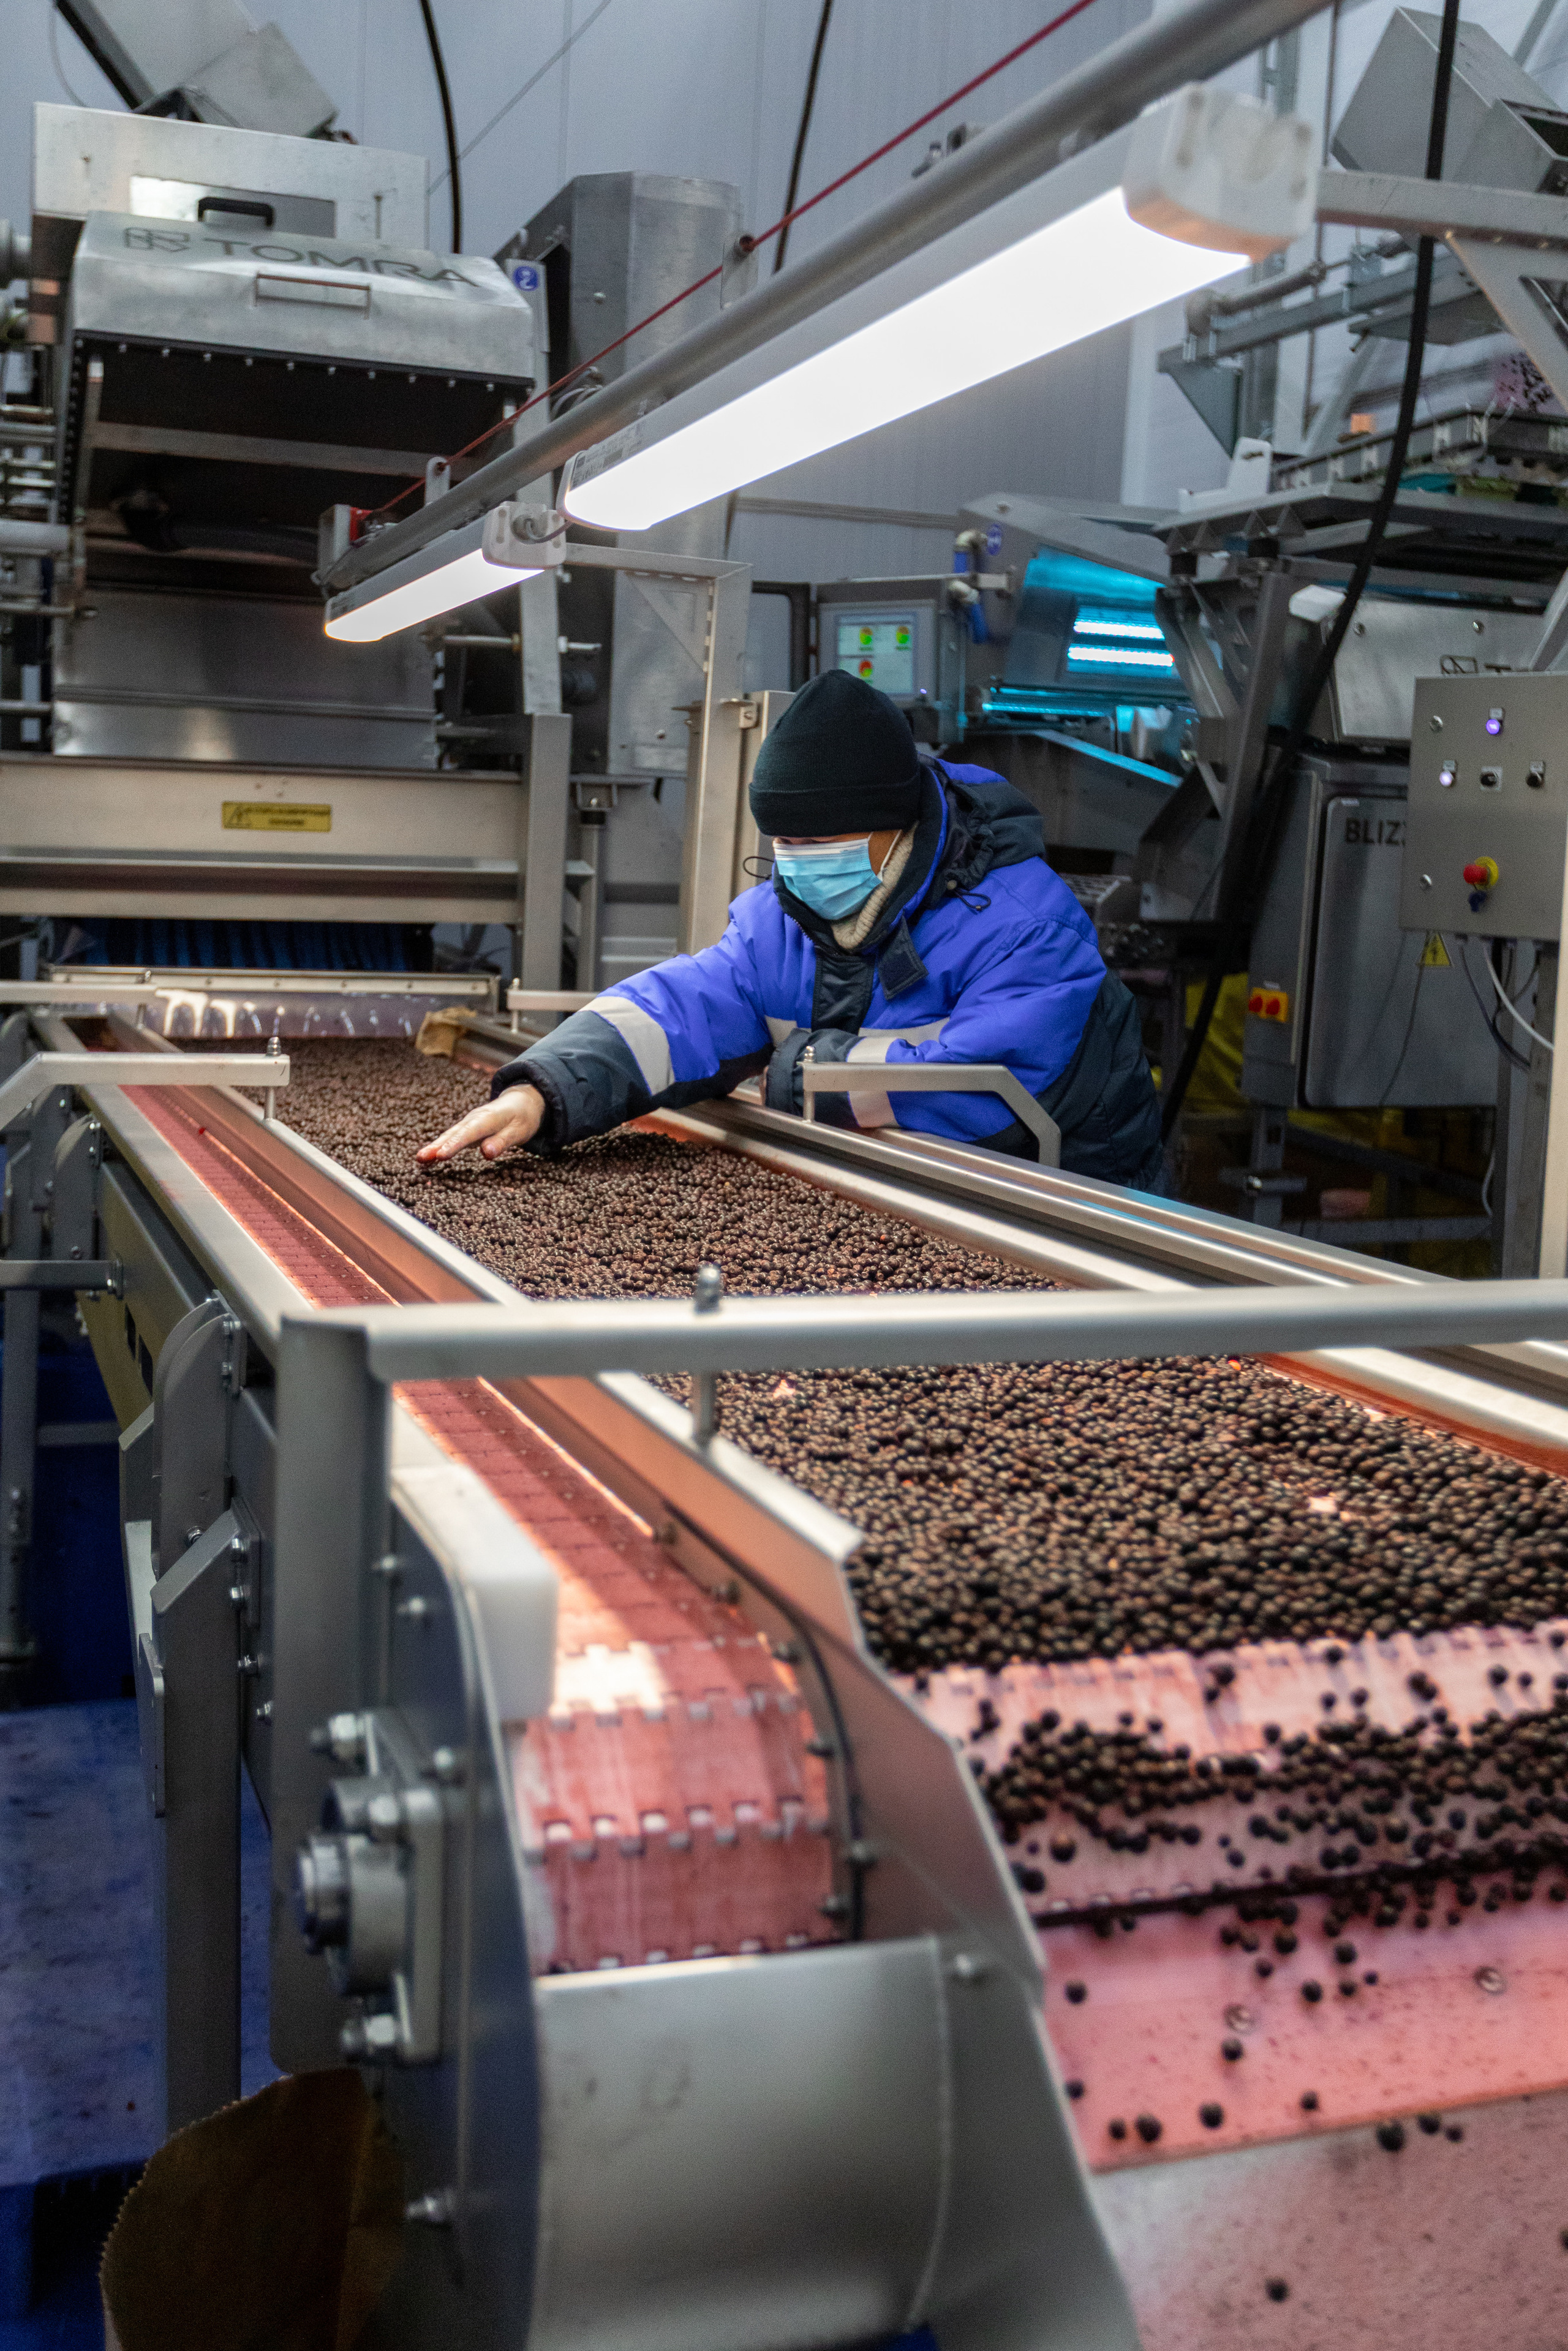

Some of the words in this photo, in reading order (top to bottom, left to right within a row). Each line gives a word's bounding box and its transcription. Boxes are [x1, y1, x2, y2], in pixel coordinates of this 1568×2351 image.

[202, 236, 480, 288] TOMRA
[519, 270, 533, 289] 2
[1344, 817, 1407, 845] BLIZ
